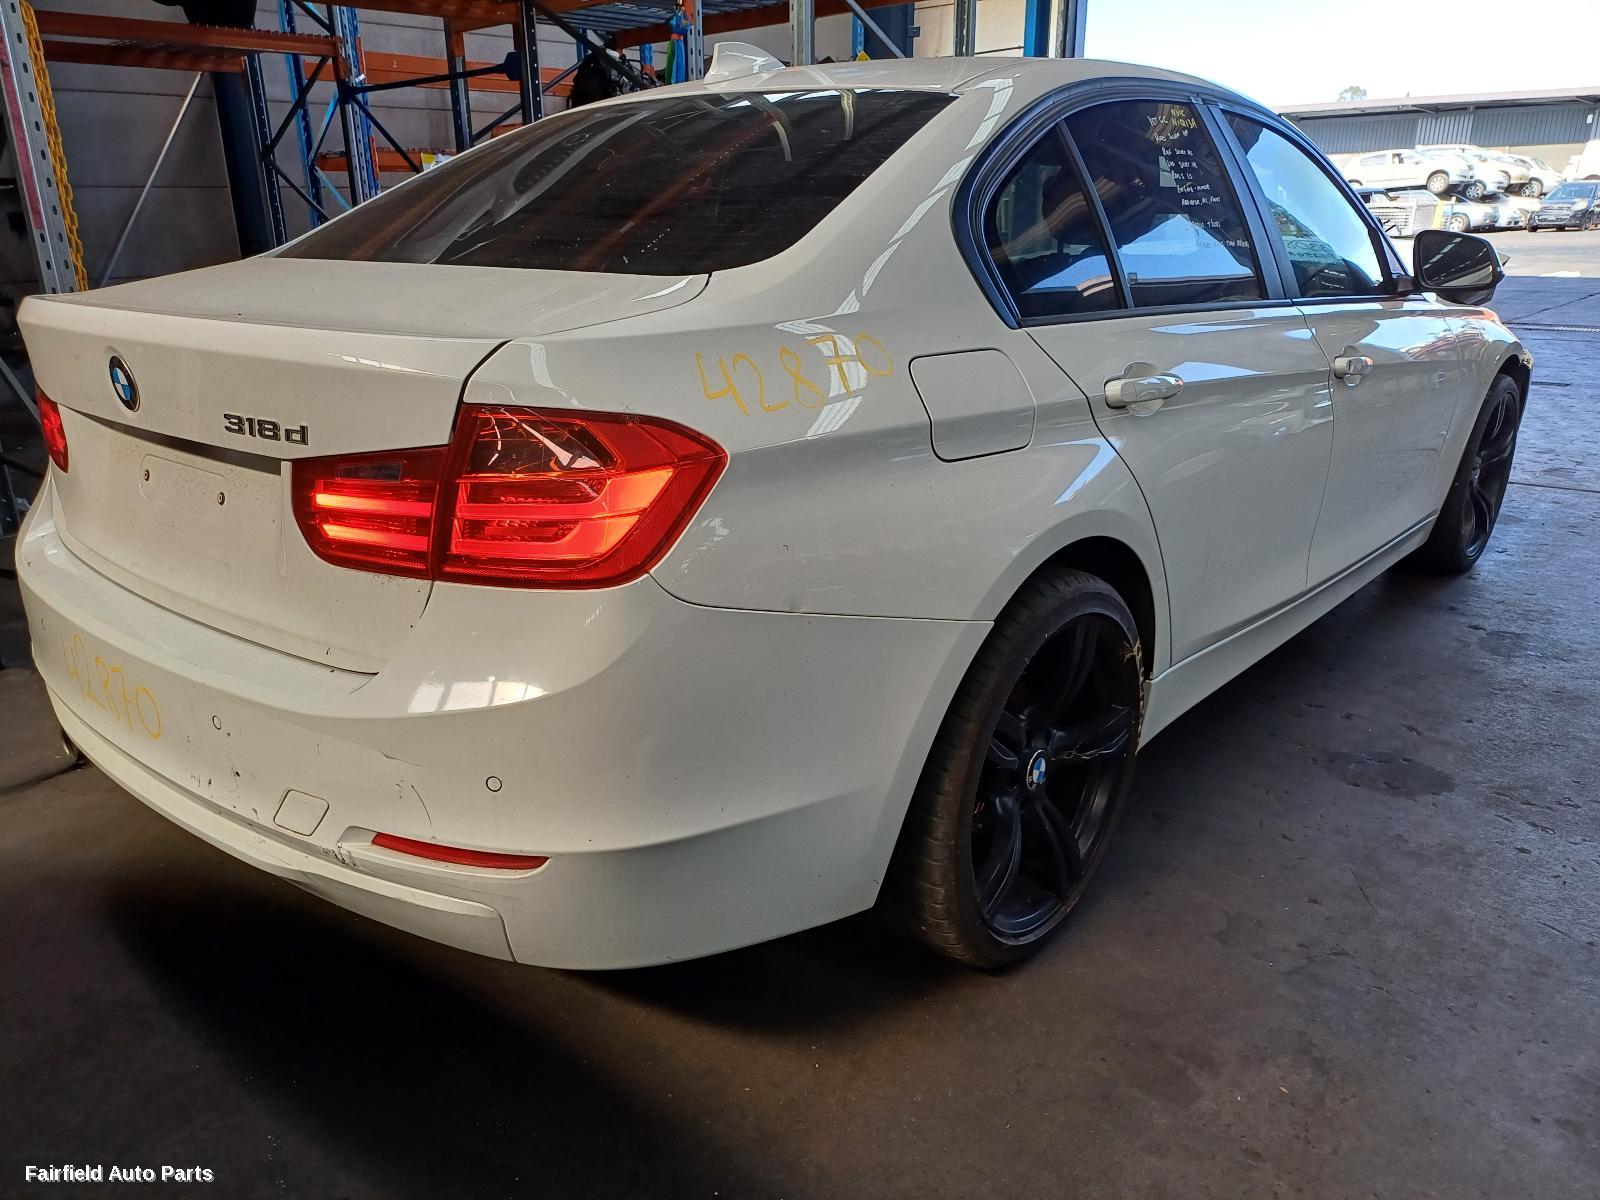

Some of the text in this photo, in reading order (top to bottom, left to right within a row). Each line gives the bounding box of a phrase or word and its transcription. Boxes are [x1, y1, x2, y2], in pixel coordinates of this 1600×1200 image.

[695, 332, 893, 416] 42870
[223, 412, 309, 446] 318d
[60, 632, 161, 740] 42870
